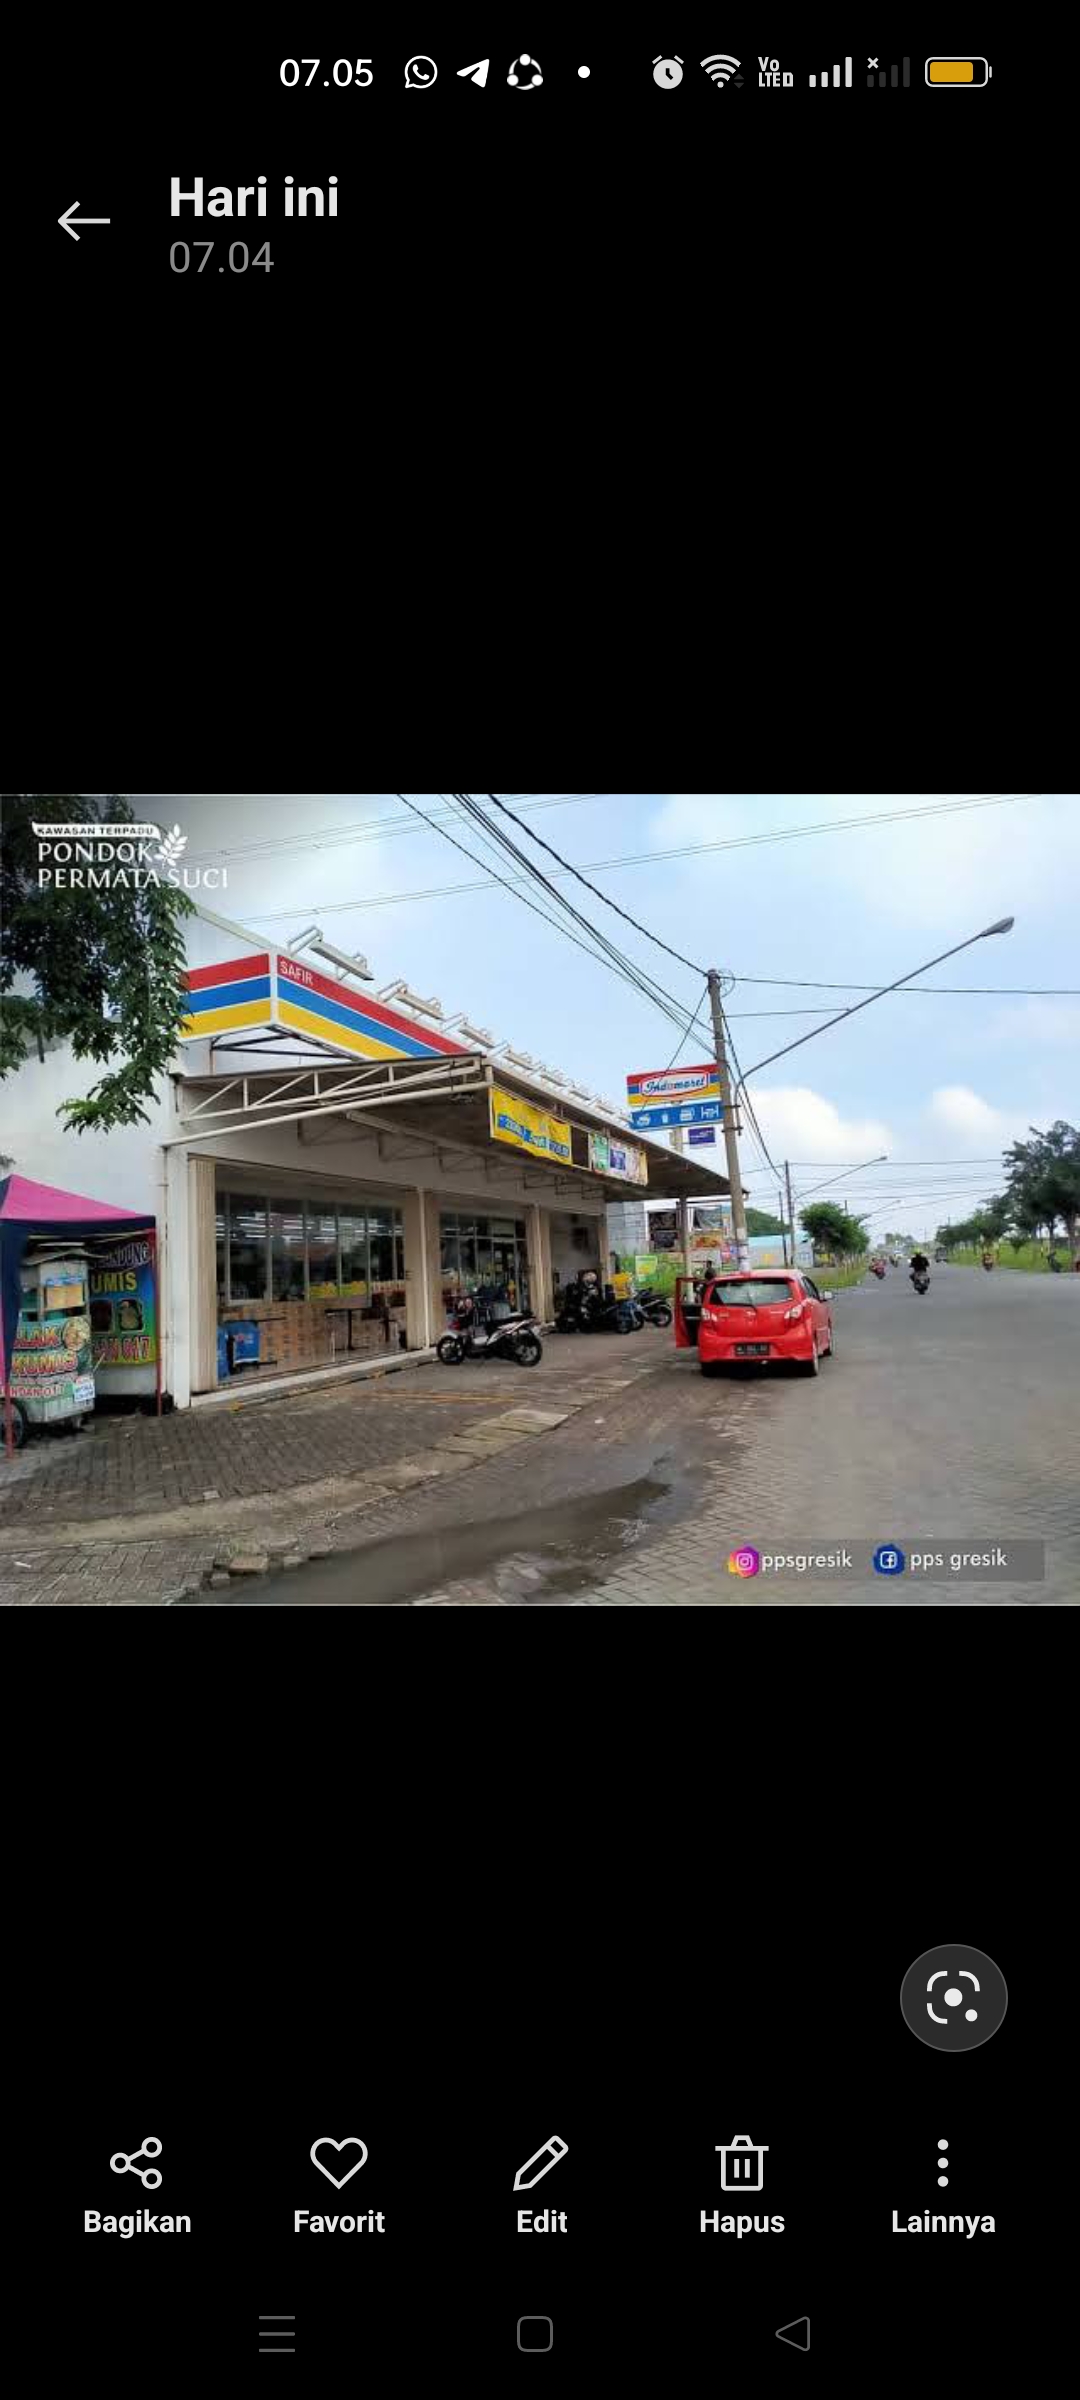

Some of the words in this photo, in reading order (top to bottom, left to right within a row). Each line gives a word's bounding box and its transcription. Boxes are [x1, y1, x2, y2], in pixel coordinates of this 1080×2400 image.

[279, 58, 374, 87] 07.05
[170, 175, 268, 218] Hari
[284, 175, 339, 218] ini
[169, 241, 275, 274] 07.04
[279, 960, 314, 986] SAFIR
[643, 1075, 706, 1094] Indomaret
[84, 2208, 191, 2239] Bagikan
[294, 2209, 386, 2234] Favorit
[517, 2208, 568, 2233] Edit
[700, 2209, 786, 2239] Hapus
[892, 2209, 996, 2240] Lainnya
